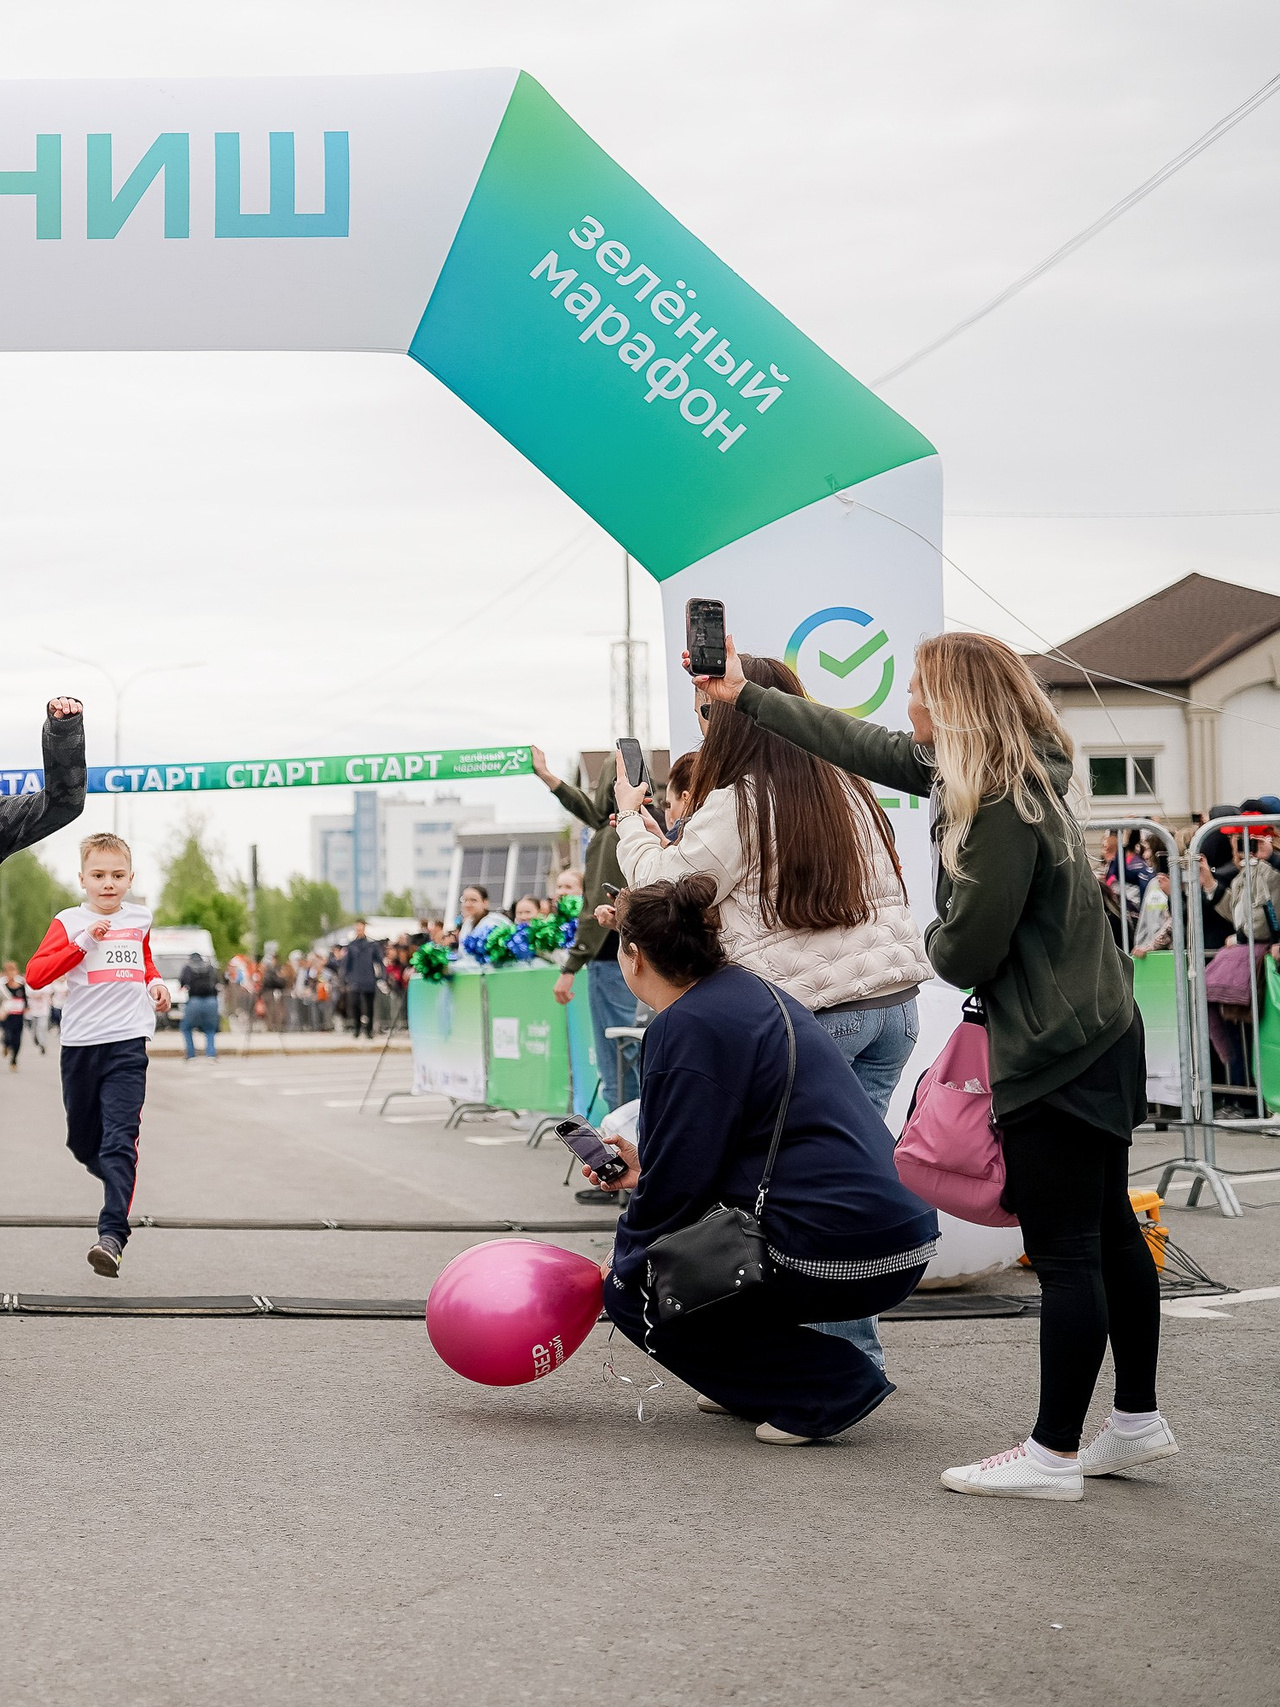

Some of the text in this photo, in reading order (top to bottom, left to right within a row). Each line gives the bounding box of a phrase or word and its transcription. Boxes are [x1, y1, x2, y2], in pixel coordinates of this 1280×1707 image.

[568, 214, 791, 415] зелёный
[528, 249, 748, 454] марафон
[104, 765, 205, 793] СТАРТ
[225, 759, 325, 788] СТАРТ
[345, 754, 443, 783] СТАРТ
[105, 950, 138, 964] 2882
[532, 1344, 551, 1380] БЕР
